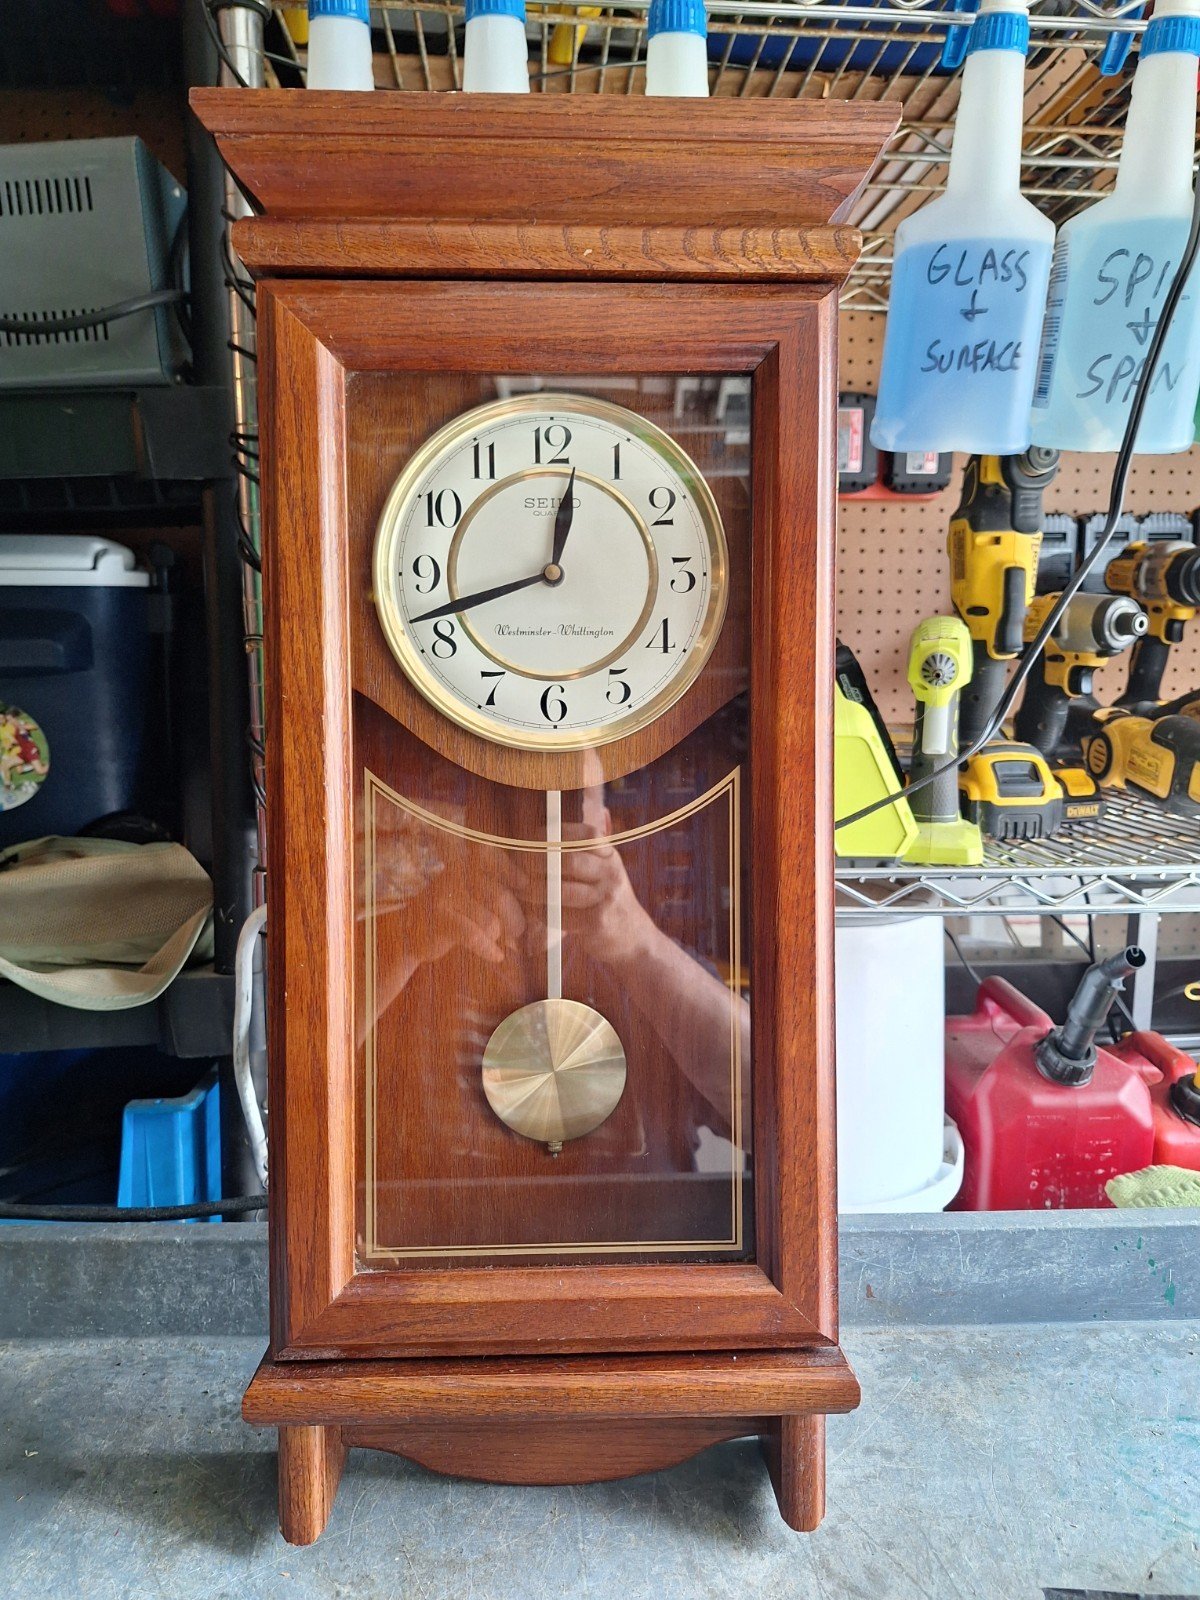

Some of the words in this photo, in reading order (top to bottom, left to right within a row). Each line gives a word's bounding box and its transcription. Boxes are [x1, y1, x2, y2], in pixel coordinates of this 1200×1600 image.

[927, 243, 1030, 292] GLASS
[1093, 248, 1190, 308] SPI
[920, 339, 1023, 374] SURFACE
[470, 441, 499, 480] 11
[532, 424, 572, 465] 12
[611, 442, 624, 480] 1
[424, 488, 462, 528] 10
[649, 486, 676, 526] 2
[412, 554, 441, 594] 9
[670, 556, 696, 594] 3
[431, 619, 458, 659] 8
[645, 617, 676, 654] 4
[480, 670, 506, 706] 7
[540, 684, 567, 722] 6
[606, 667, 631, 704] 5
